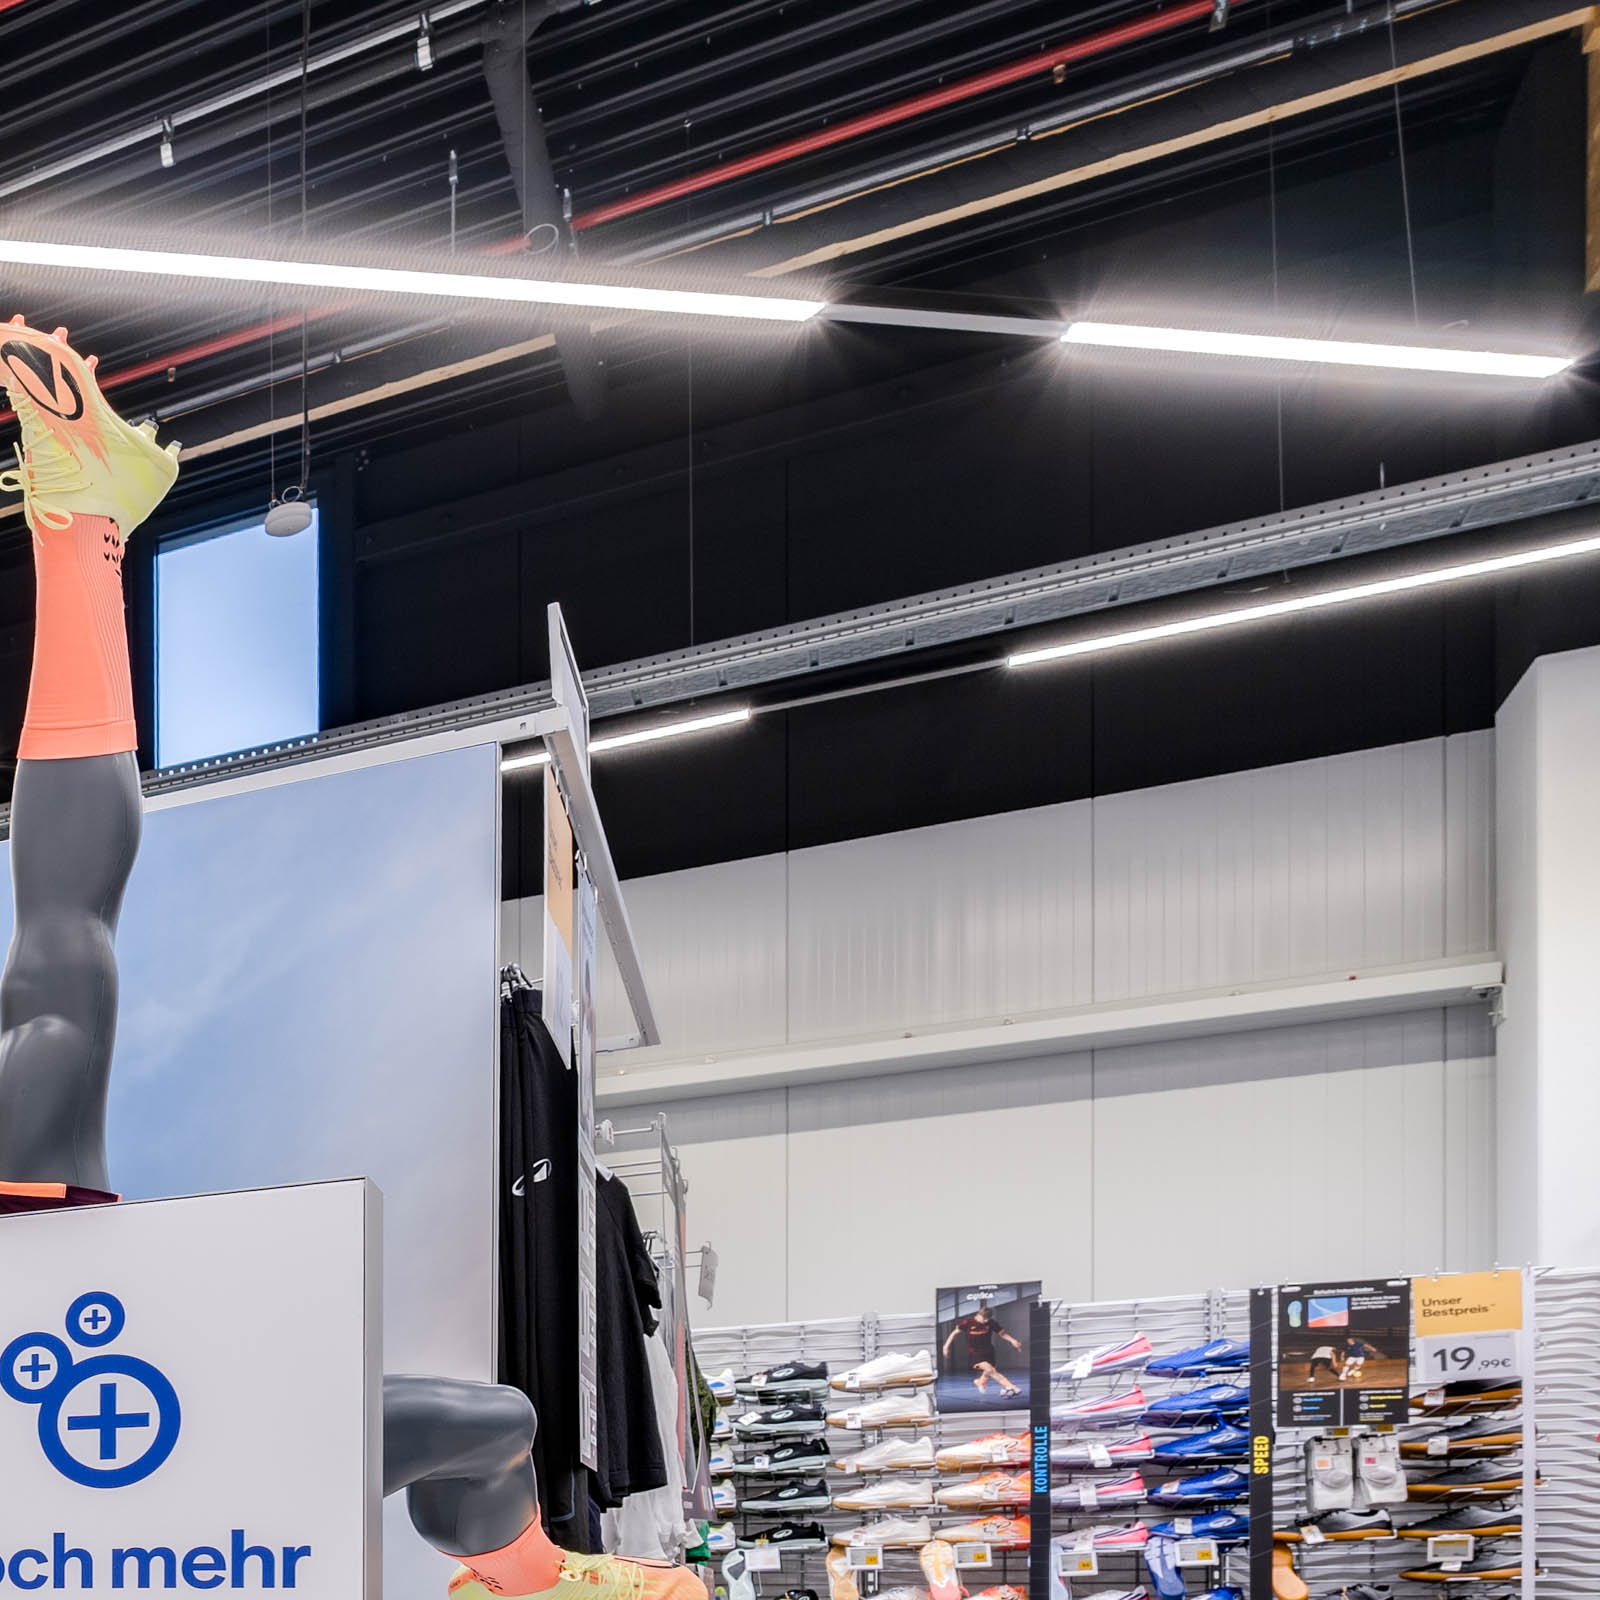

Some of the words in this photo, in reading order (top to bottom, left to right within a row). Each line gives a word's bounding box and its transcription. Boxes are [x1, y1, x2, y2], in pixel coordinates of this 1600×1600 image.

[1421, 1296, 1462, 1308] Unser
[1034, 1426, 1049, 1493] KONTROLLE
[1253, 1434, 1270, 1475] SPEED
[111, 1529, 312, 1589] mehr
